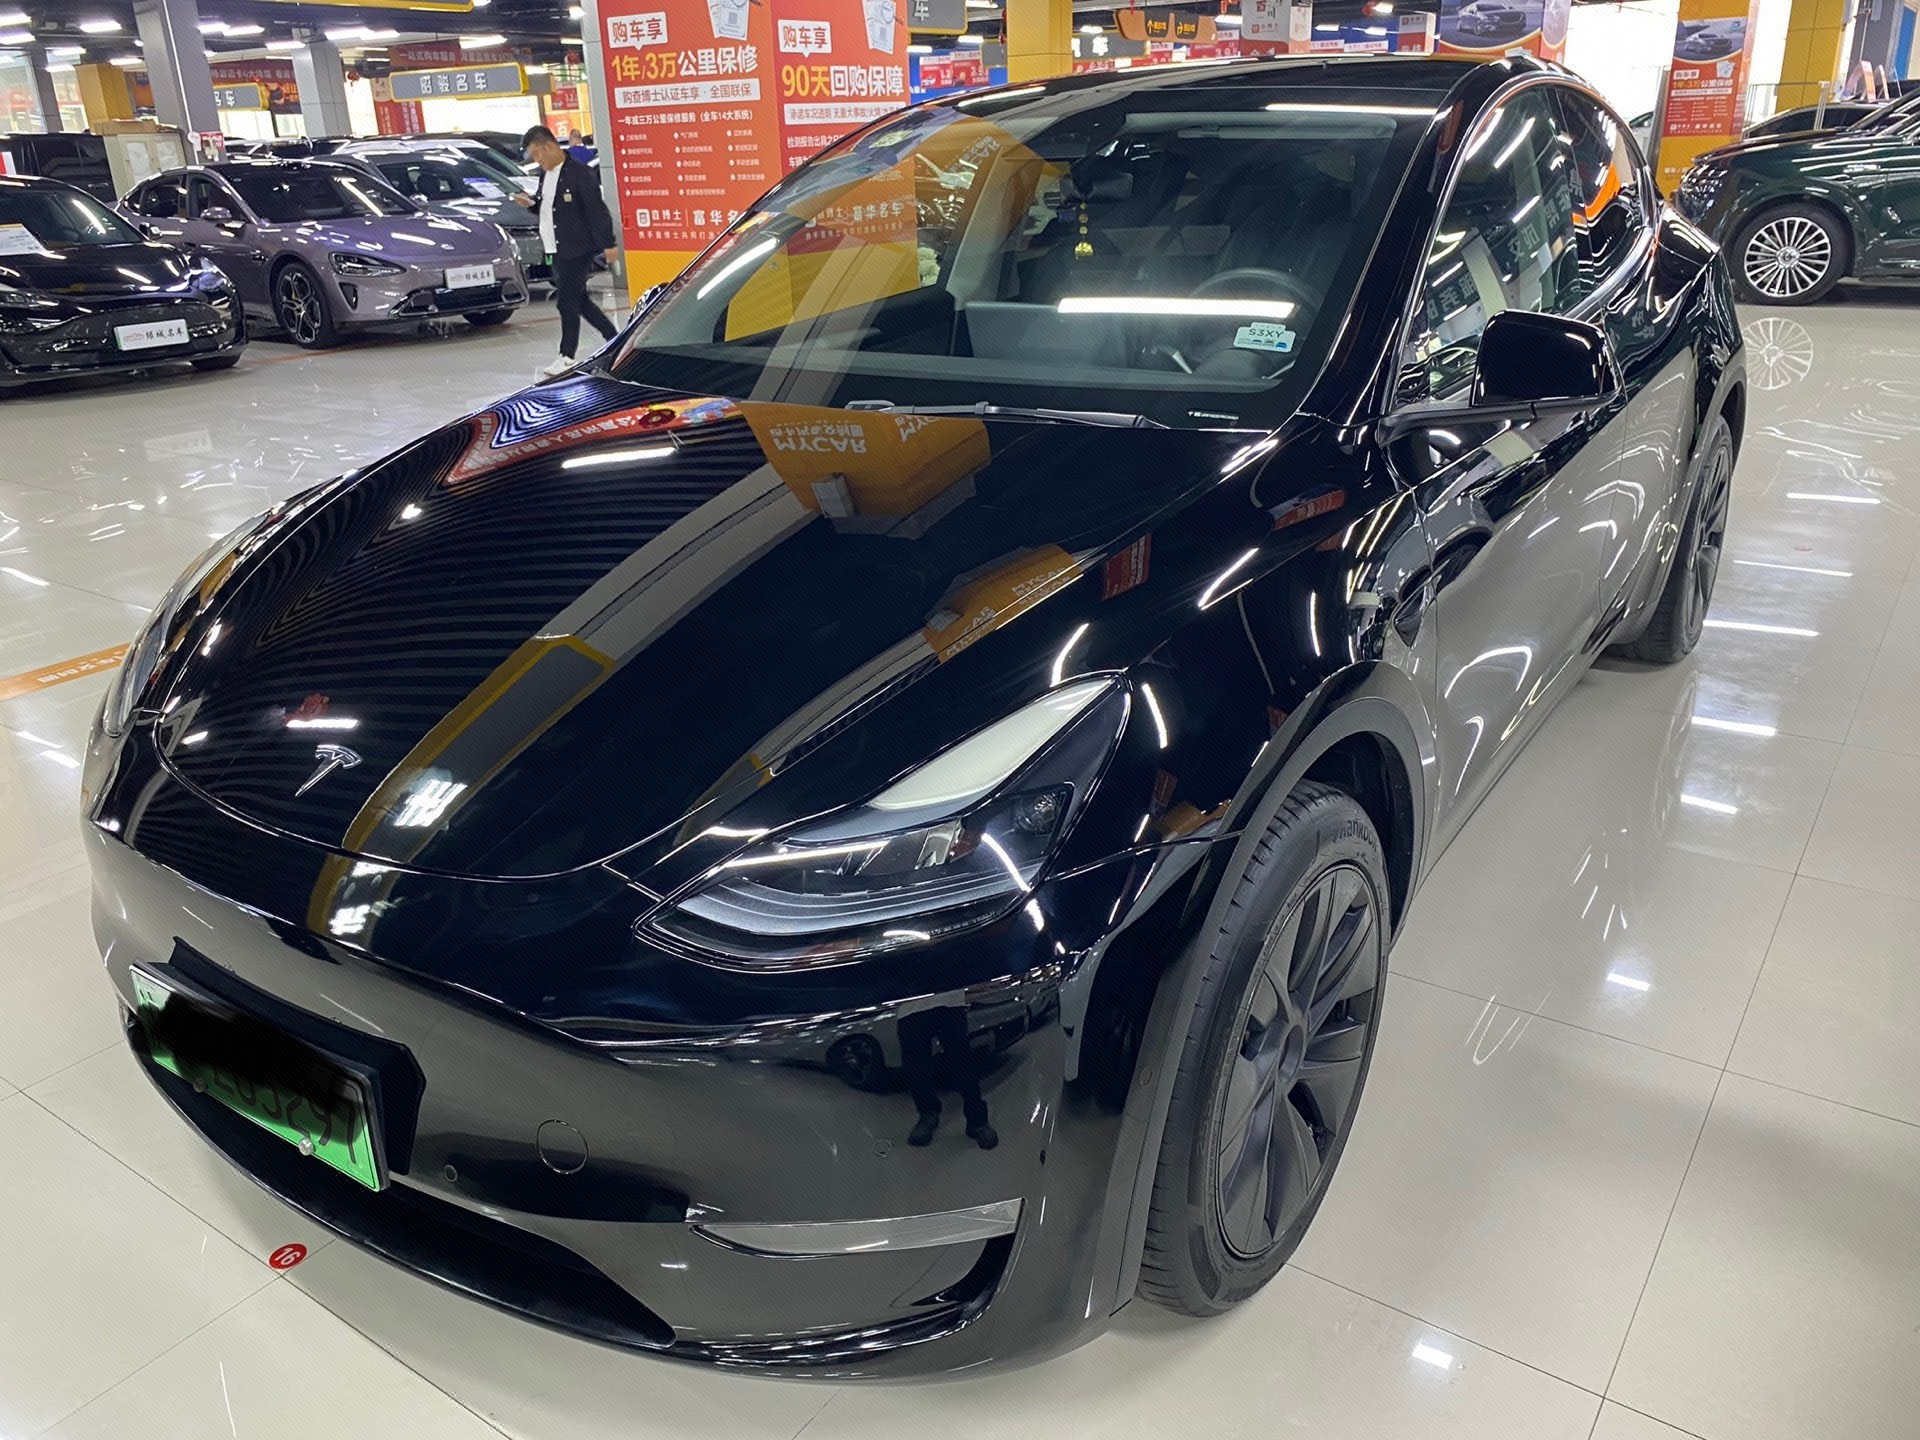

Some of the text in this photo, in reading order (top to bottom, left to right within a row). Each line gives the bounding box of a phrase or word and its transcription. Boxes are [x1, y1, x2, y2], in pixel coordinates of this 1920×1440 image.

[612, 17, 664, 43] 购车享
[783, 26, 828, 48] 购车享
[611, 44, 759, 82] 1年/3万公里保修
[782, 65, 904, 97] 90天回购保障
[1249, 328, 1284, 339] S3XY
[274, 1247, 300, 1265] 16
